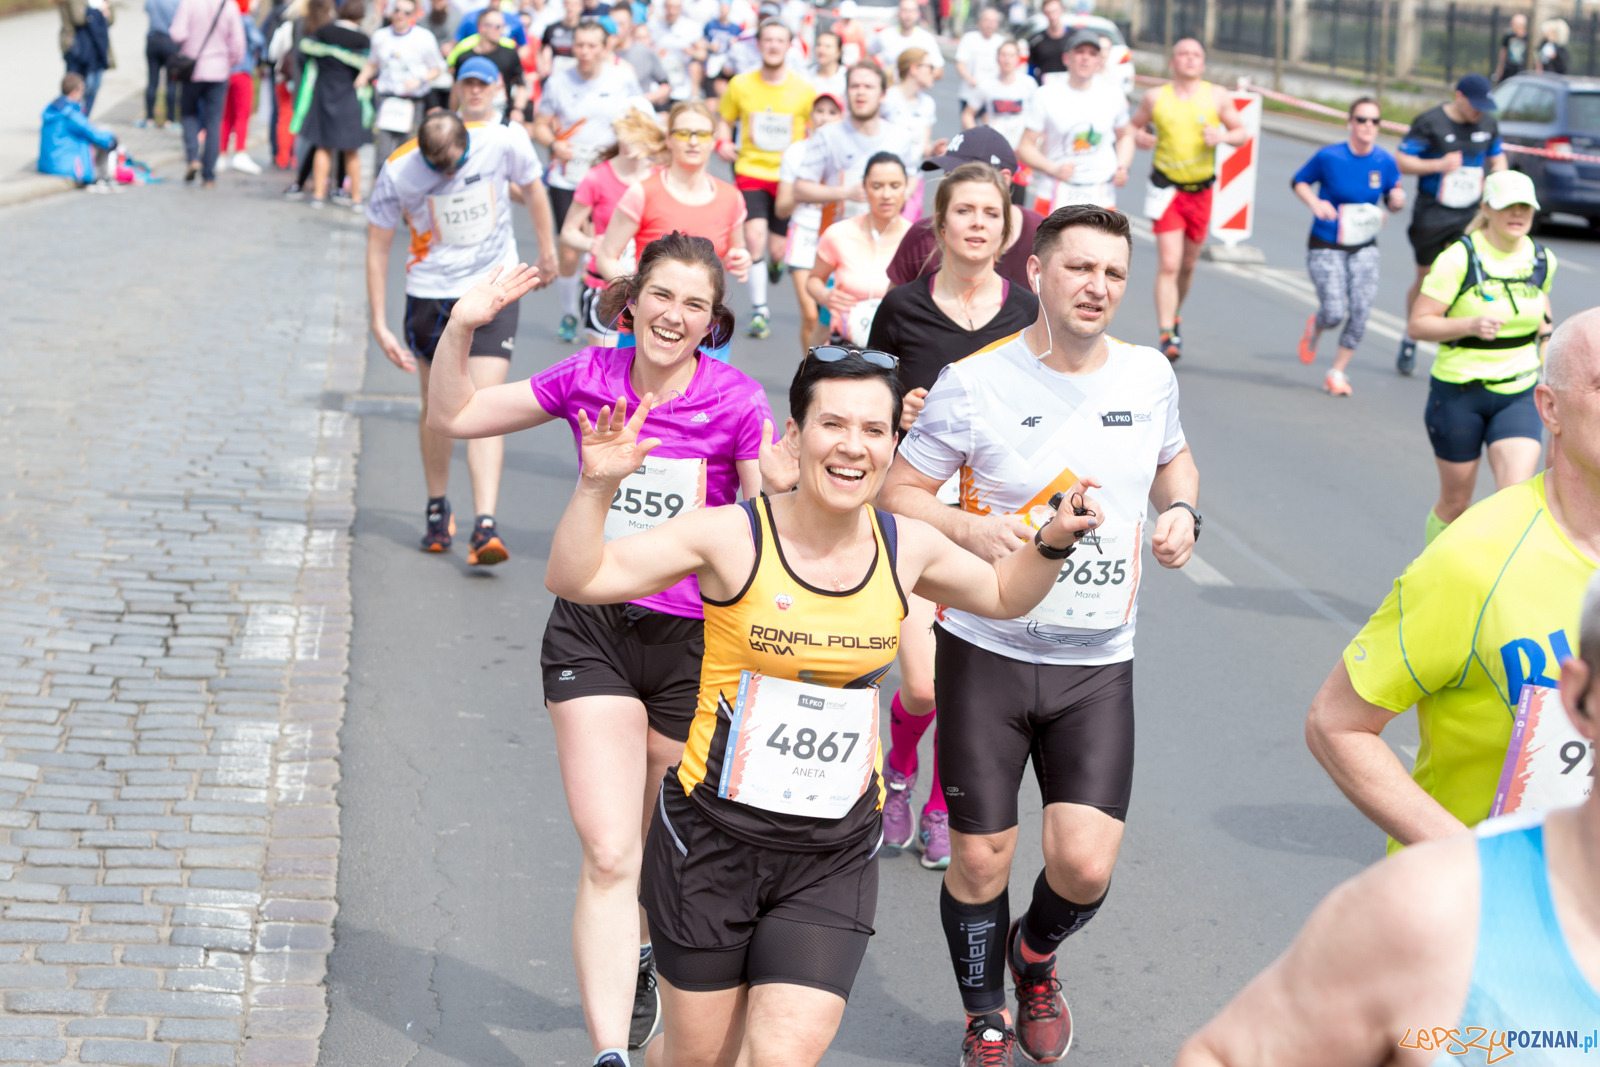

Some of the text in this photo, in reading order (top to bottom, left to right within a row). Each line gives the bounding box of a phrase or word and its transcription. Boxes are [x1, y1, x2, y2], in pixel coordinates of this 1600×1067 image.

[442, 203, 488, 225] 12153
[1056, 558, 1127, 586] 9635
[1075, 591, 1101, 599] Marek
[750, 624, 897, 650] RONAL POLSKA
[766, 722, 860, 764] 4867
[792, 766, 825, 779] ANETA
